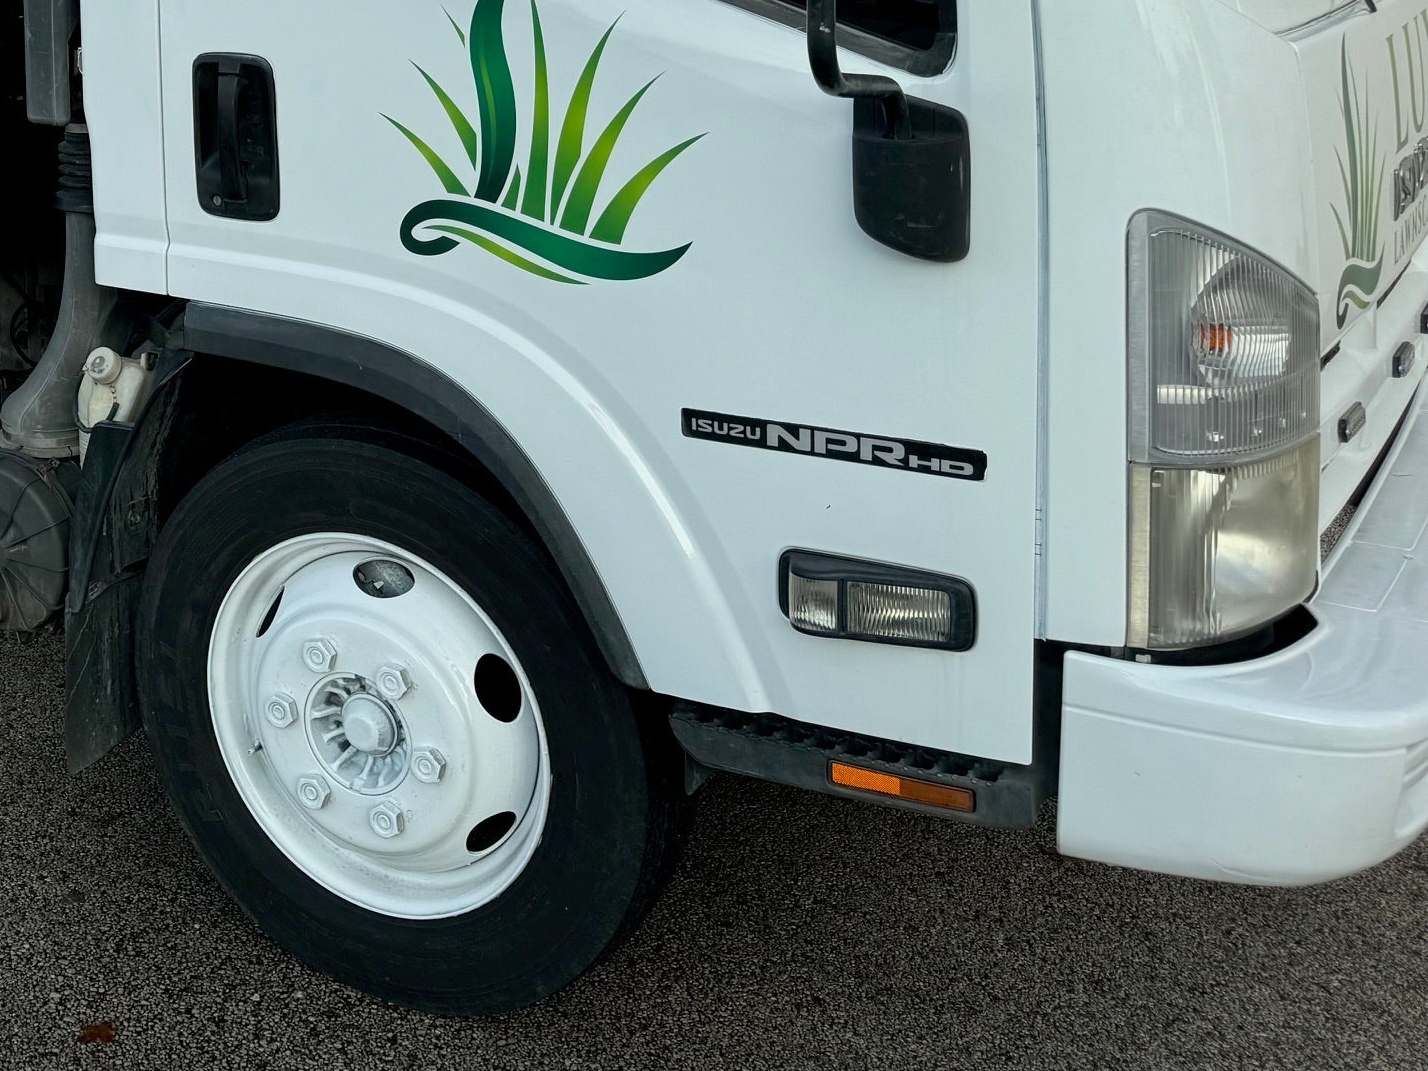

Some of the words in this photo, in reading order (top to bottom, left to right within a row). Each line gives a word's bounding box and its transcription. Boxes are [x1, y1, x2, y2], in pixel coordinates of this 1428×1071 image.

[691, 417, 761, 440] ISUZU
[766, 423, 905, 466] NPR
[908, 454, 974, 476] HD
